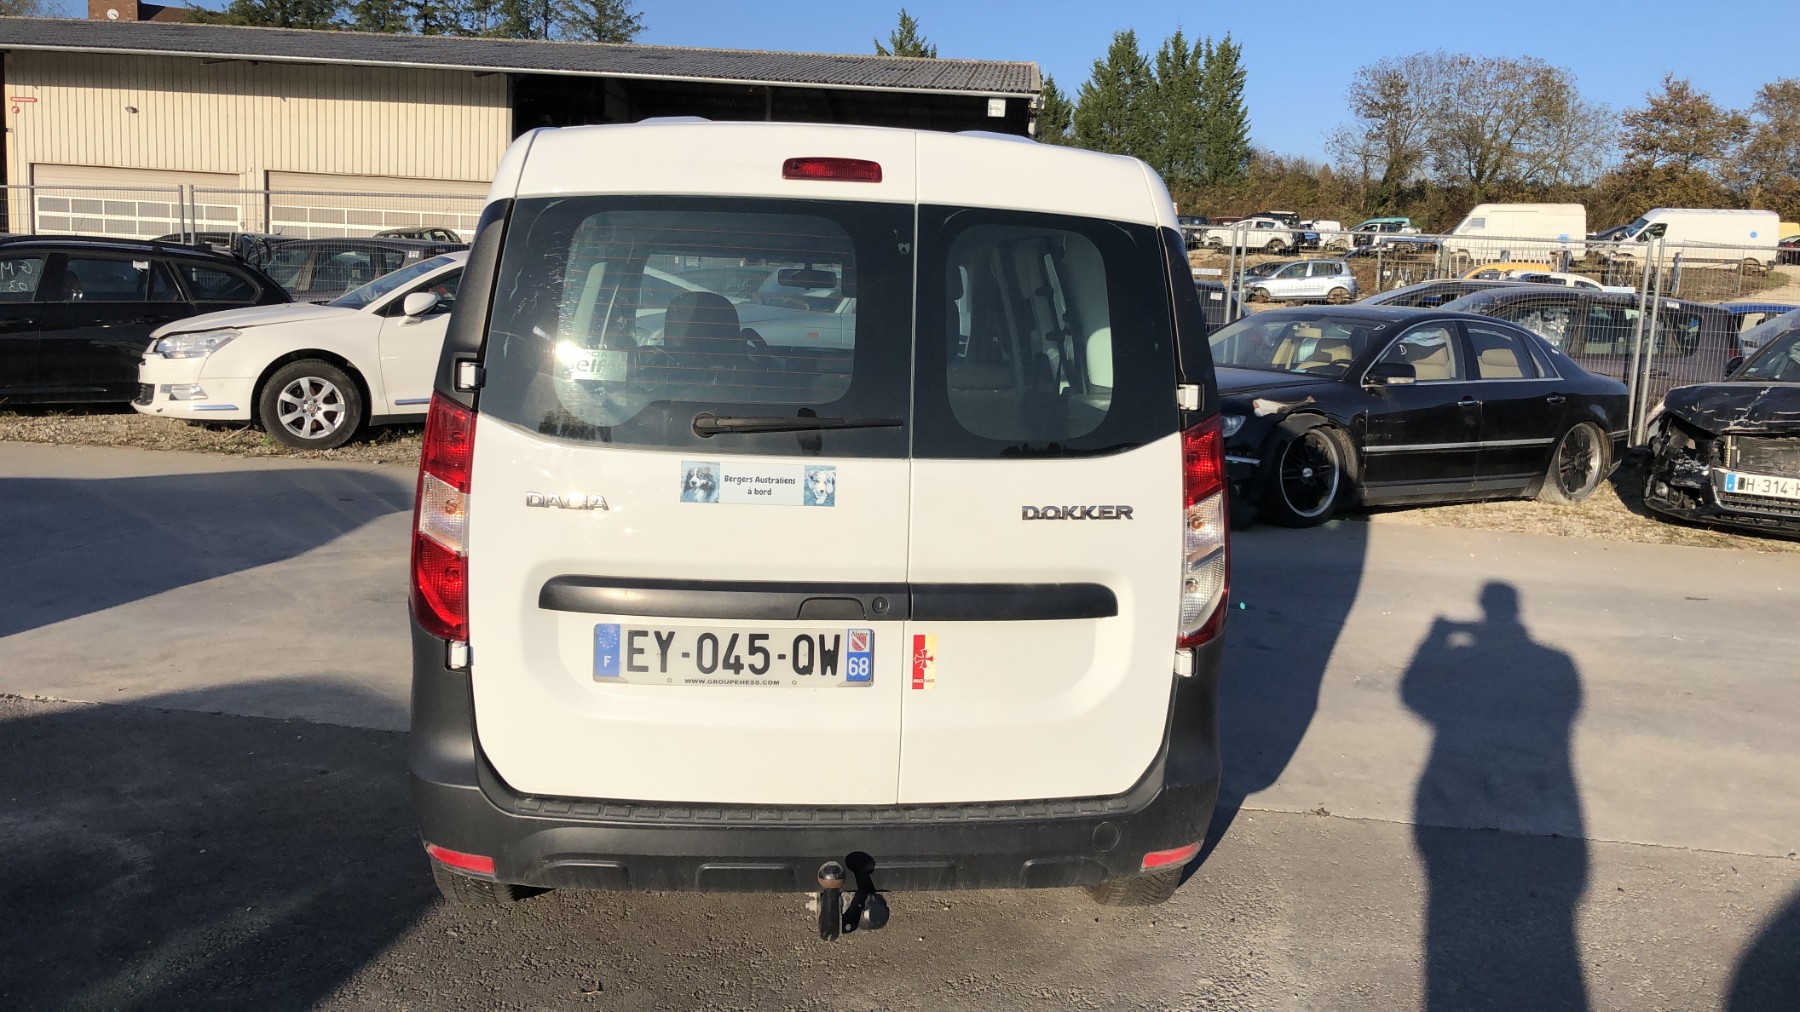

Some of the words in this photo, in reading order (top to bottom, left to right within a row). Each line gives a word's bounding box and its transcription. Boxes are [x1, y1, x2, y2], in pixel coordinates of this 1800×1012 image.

[724, 474, 753, 485] Bergers
[755, 476, 796, 485] Australiens
[747, 487, 753, 495] à
[754, 488, 772, 496] bord
[526, 491, 609, 510] DACIA
[1021, 505, 1134, 520] DOKKER
[627, 629, 841, 676] EY-045-QW
[603, 655, 612, 667] F
[848, 656, 869, 676] 68
[684, 678, 780, 686] WWW.GROUPEHESS.COM
